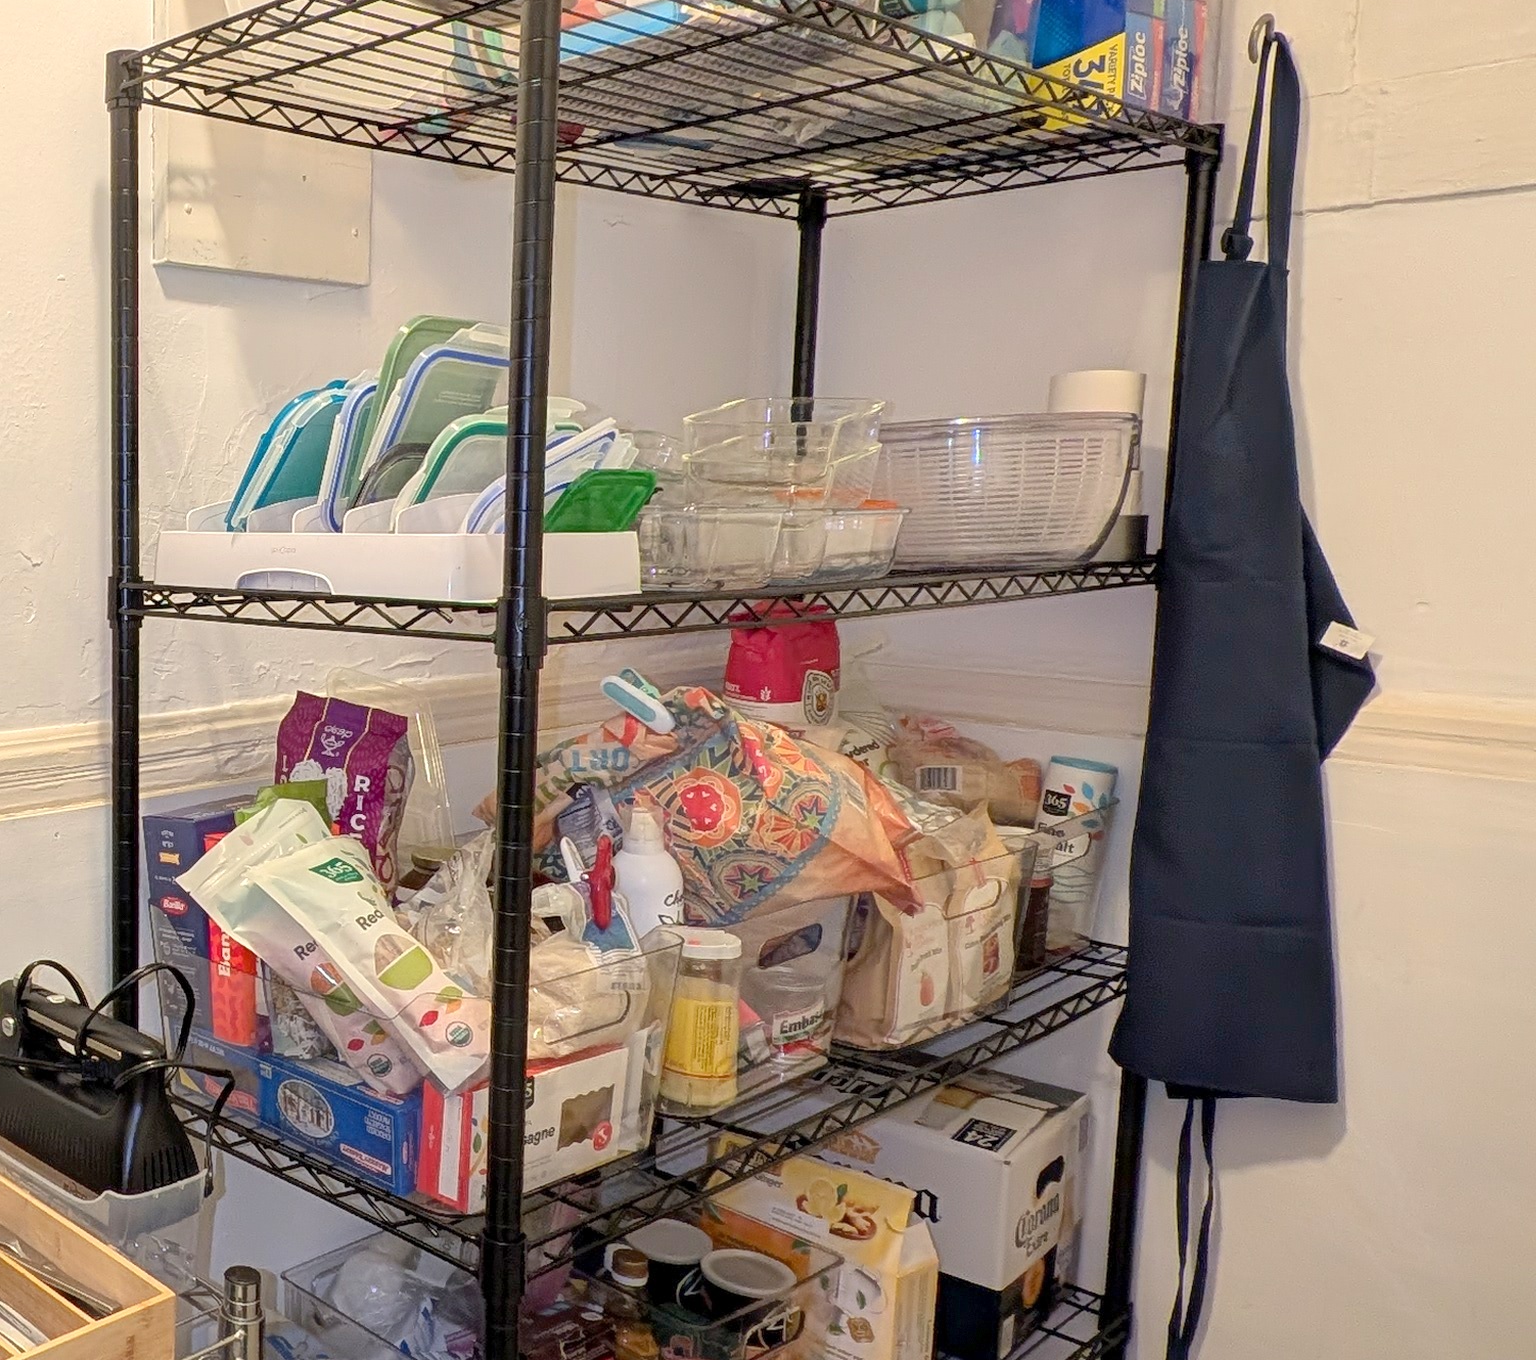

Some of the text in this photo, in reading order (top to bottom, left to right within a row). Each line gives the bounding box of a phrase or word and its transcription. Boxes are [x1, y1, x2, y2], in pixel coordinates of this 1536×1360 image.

[1130, 31, 1146, 93] Ziploc
[1172, 27, 1189, 87] Ziploc
[350, 775, 371, 838] RIC
[1044, 792, 1068, 809] 365
[217, 935, 232, 977] Ban
[293, 939, 319, 961] Re
[522, 1126, 556, 1146] sagne
